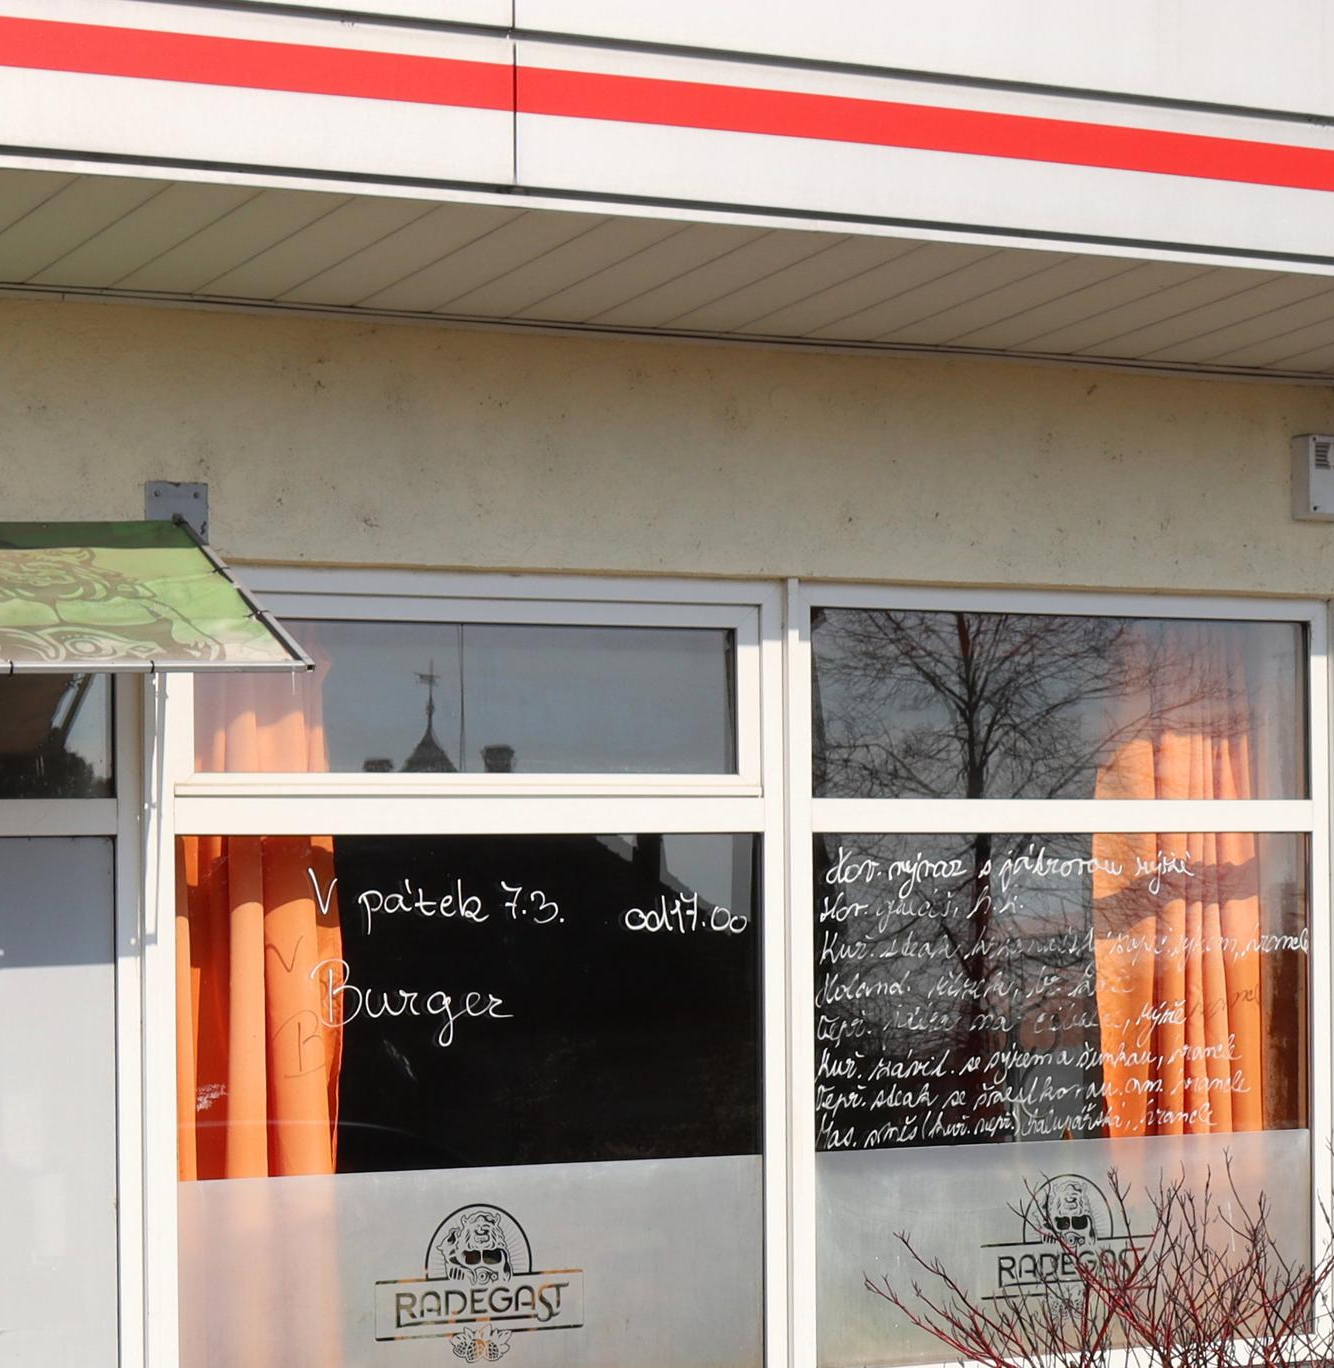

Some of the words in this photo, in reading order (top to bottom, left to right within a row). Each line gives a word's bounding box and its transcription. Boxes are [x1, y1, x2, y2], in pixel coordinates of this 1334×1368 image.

[308, 867, 338, 915] V
[358, 878, 489, 935] pátek
[501, 880, 565, 924] 7.3.
[310, 958, 514, 1047] Burger
[998, 1247, 1145, 1288] RADEGAS
[395, 1282, 569, 1328] RADEGAST
